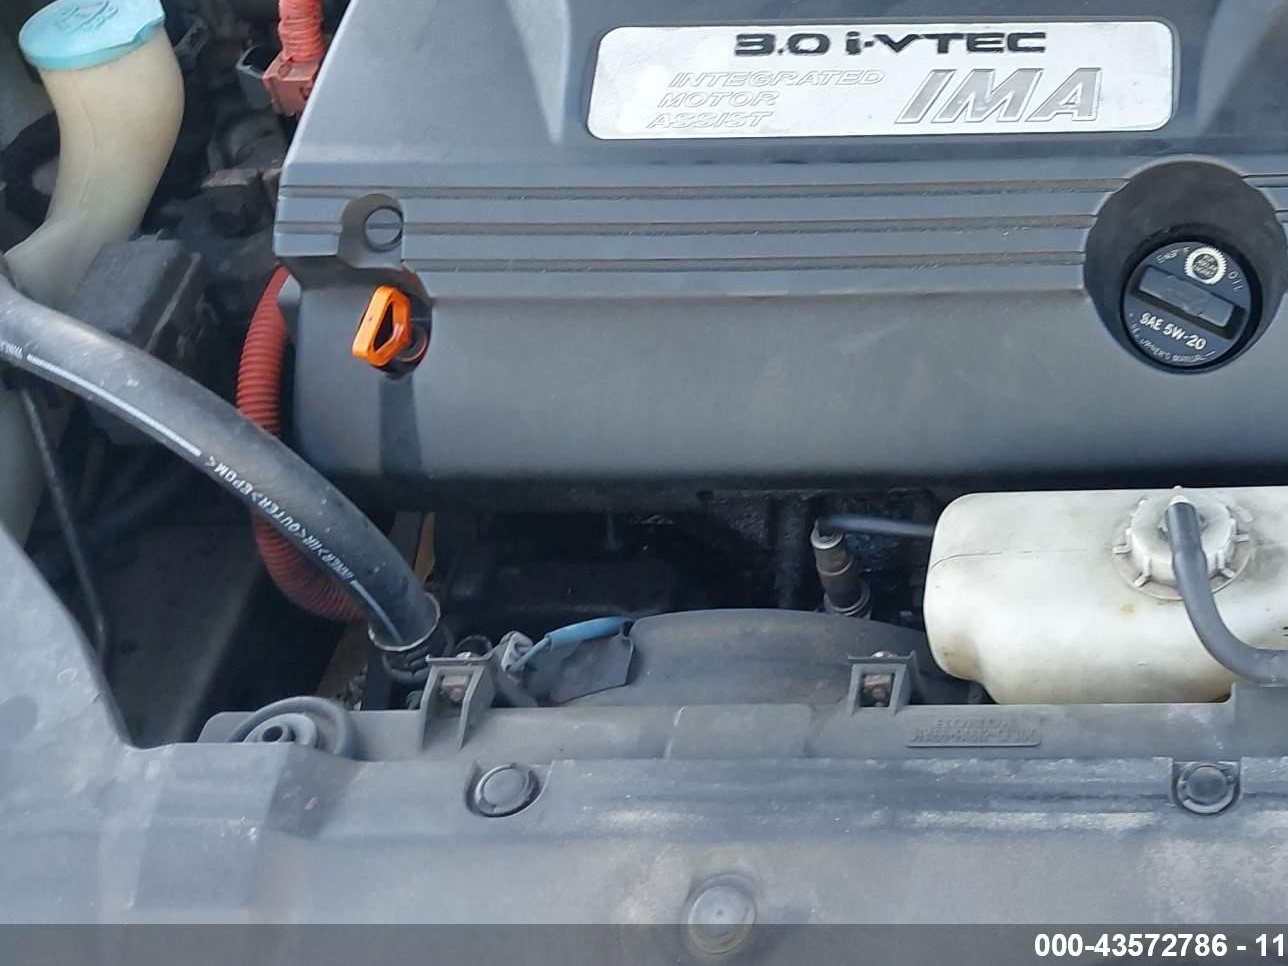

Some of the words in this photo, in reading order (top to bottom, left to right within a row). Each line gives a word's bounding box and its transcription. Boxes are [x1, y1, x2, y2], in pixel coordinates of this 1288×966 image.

[734, 33, 832, 56] 3.0
[845, 31, 1047, 55] i-VTEC
[668, 69, 885, 88] INTEGRATED
[657, 90, 781, 108] MOTOR
[894, 67, 1103, 124] IMA
[645, 110, 774, 129] ASSIST
[1139, 312, 1163, 331] SAE
[1163, 323, 1207, 351] 5W-20
